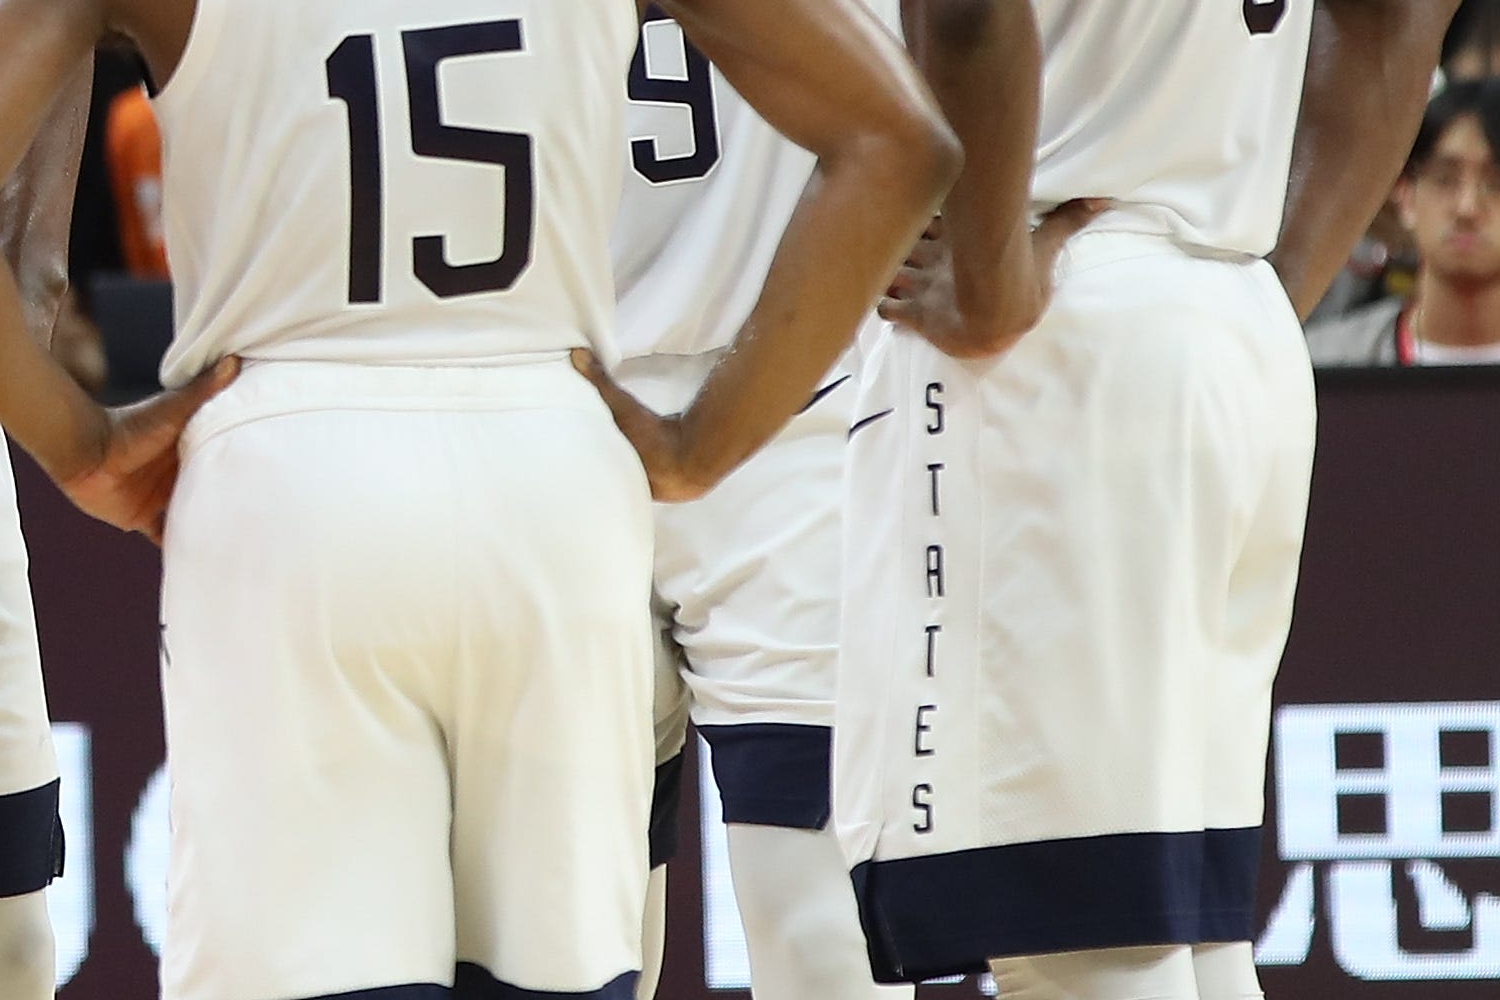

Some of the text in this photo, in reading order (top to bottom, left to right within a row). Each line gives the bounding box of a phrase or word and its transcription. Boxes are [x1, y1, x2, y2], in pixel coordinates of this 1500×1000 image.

[325, 17, 536, 305] 15
[627, 3, 722, 186] 9
[911, 380, 947, 836] STATES
